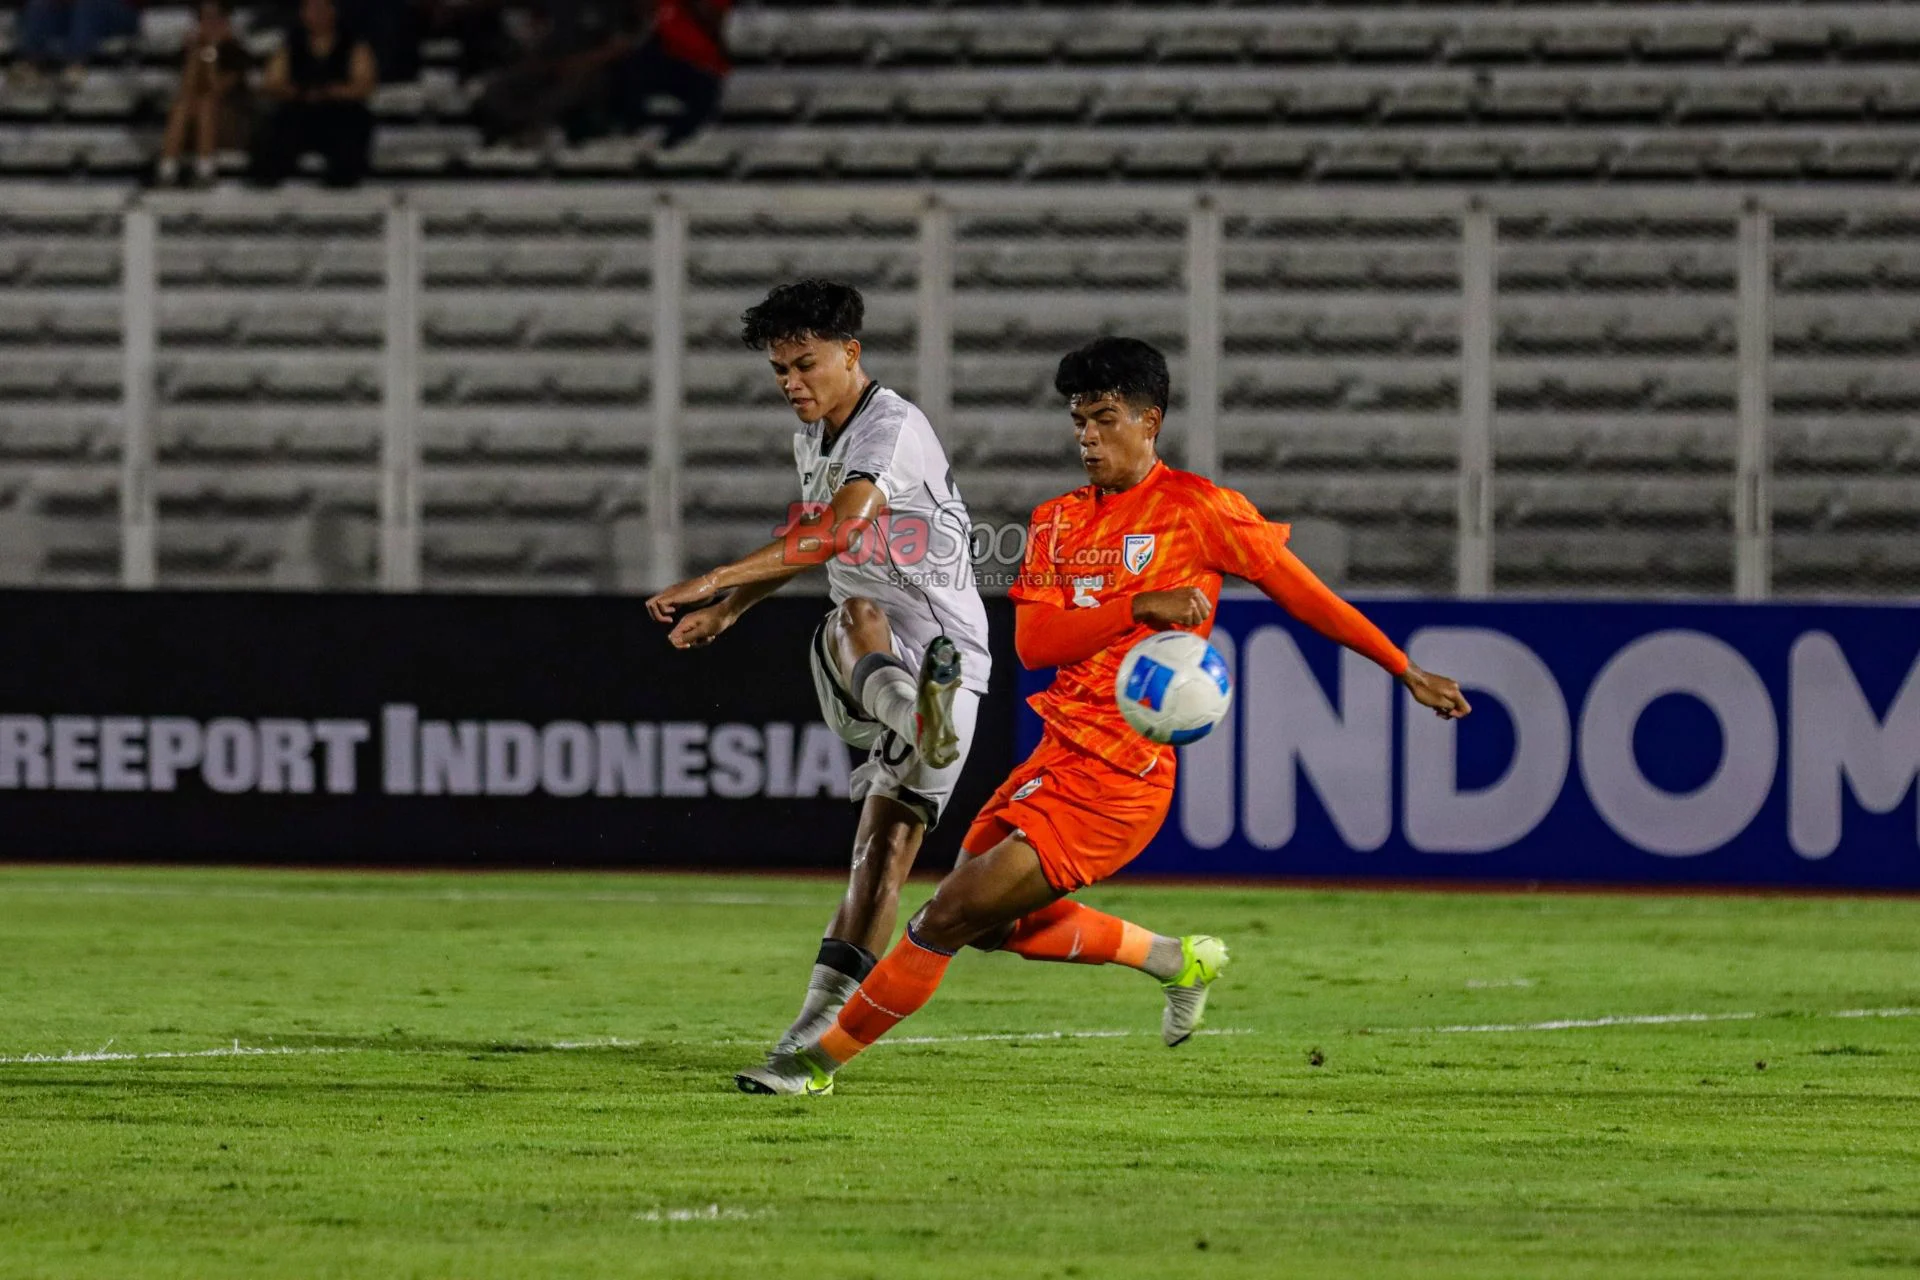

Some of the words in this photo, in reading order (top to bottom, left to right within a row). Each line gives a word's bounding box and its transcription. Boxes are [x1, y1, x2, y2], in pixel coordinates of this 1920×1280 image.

[0, 713, 369, 793] REEPORT
[381, 703, 851, 798] INDONESIA
[1179, 624, 1920, 860] INDOM
